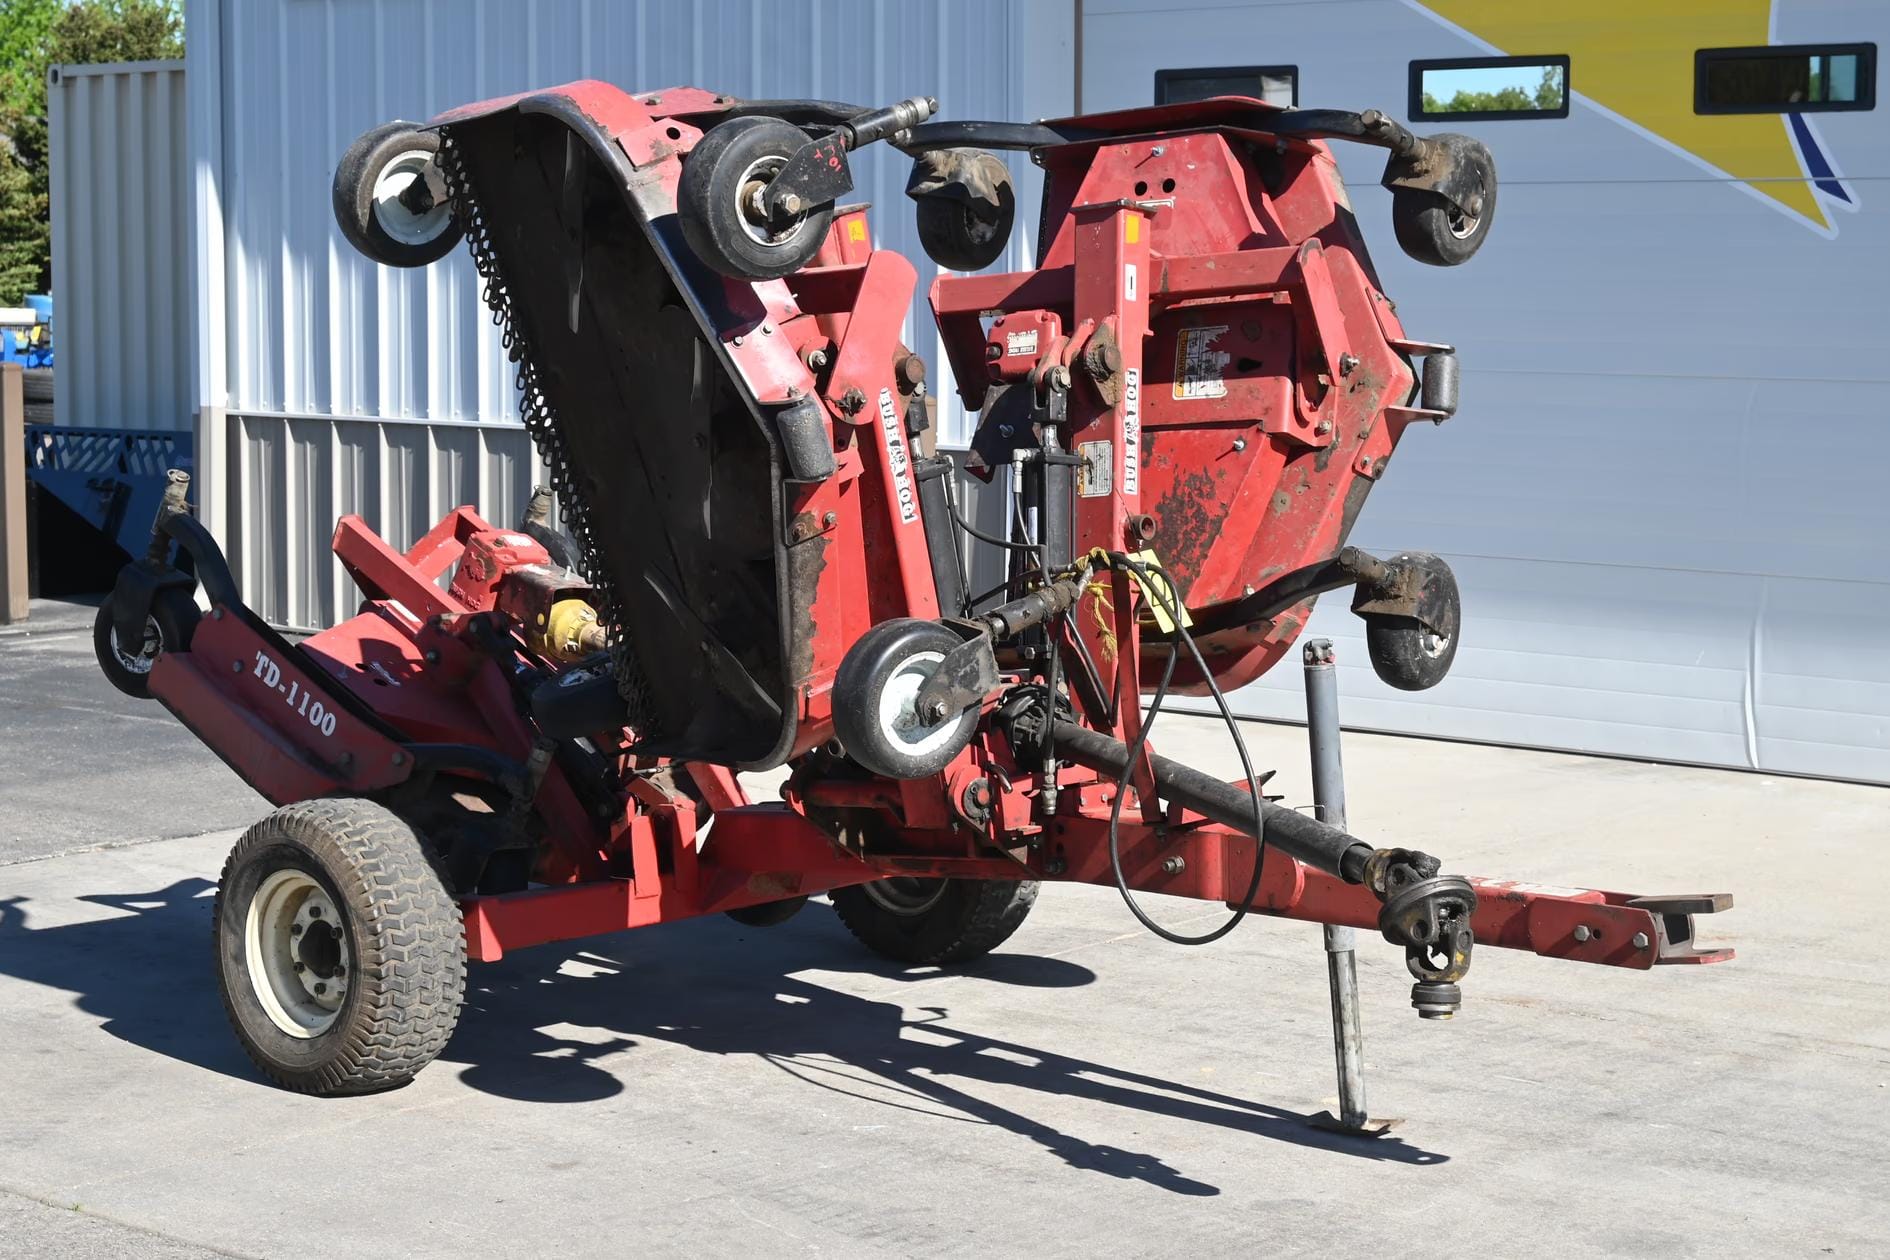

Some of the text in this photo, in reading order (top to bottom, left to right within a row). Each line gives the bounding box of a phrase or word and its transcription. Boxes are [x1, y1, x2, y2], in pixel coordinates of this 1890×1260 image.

[879, 388, 916, 518] BUSH HOG
[1125, 372, 1138, 491] BUSH HOG
[253, 650, 337, 737] TD-1100
